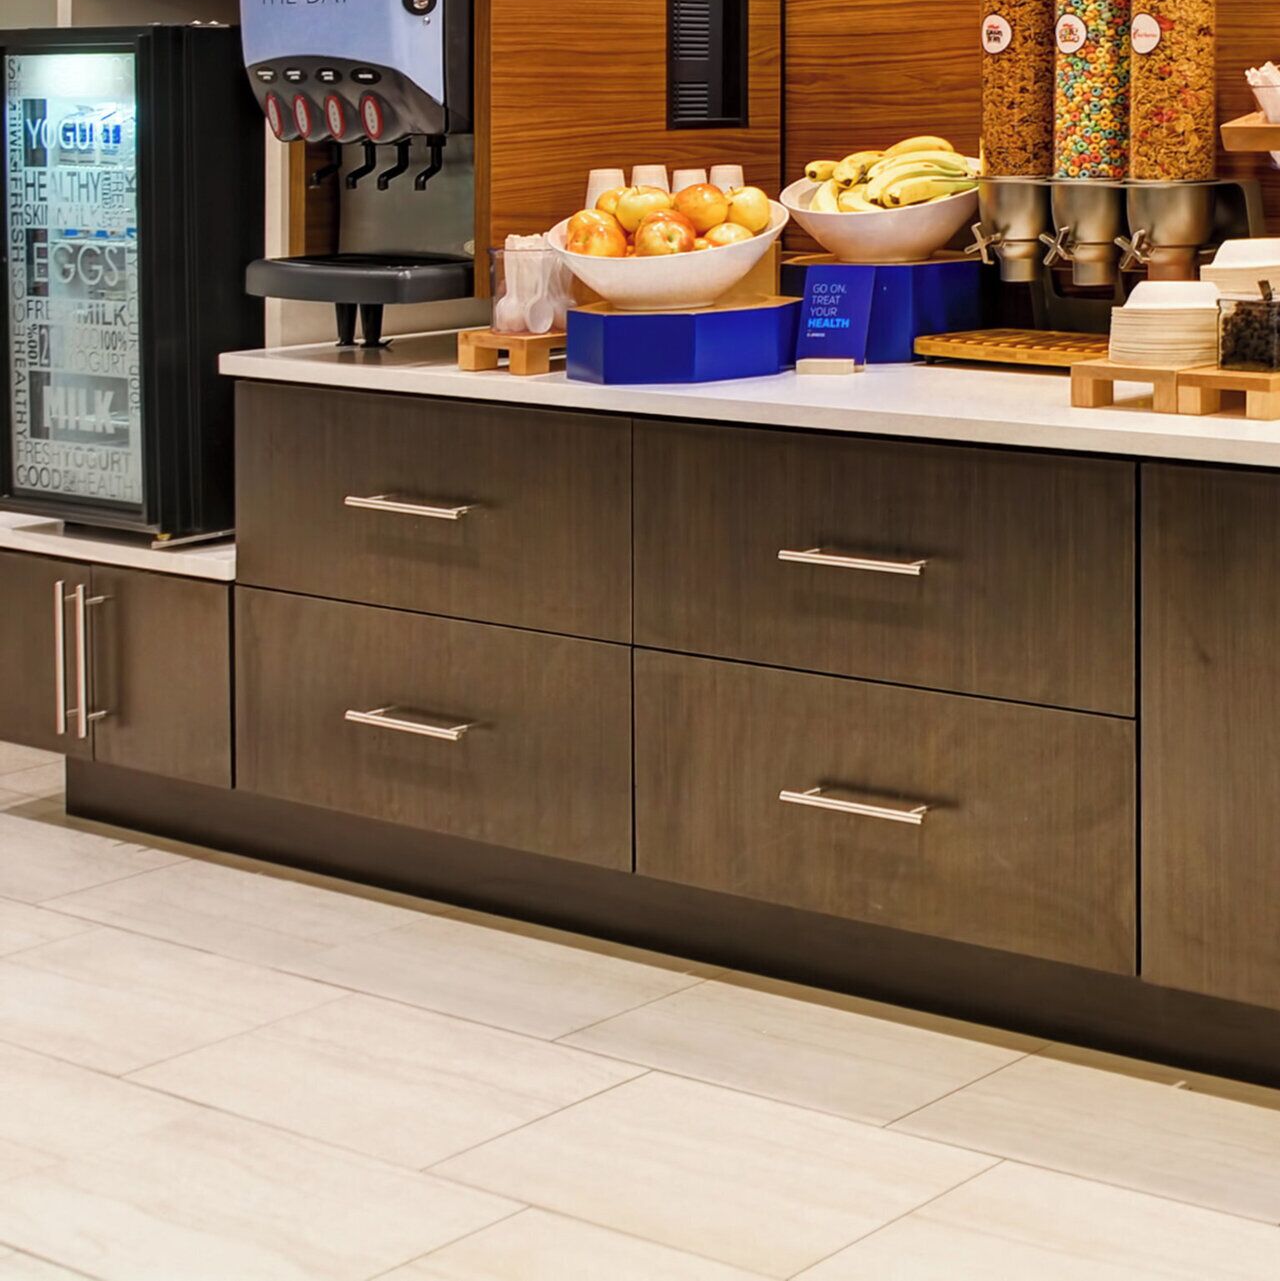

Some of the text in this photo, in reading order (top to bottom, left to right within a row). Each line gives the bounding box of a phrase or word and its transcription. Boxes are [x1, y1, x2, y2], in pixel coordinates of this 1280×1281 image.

[24, 171, 100, 203] HEALTHY
[33, 242, 120, 287] EGGS
[811, 295, 841, 306] TREAT
[812, 283, 828, 294] GO
[807, 318, 850, 329] HEALTH
[810, 306, 838, 317] YOUR
[14, 340, 27, 440] HEALTHY
[42, 385, 116, 434] MILK
[16, 463, 61, 490] GOOD
